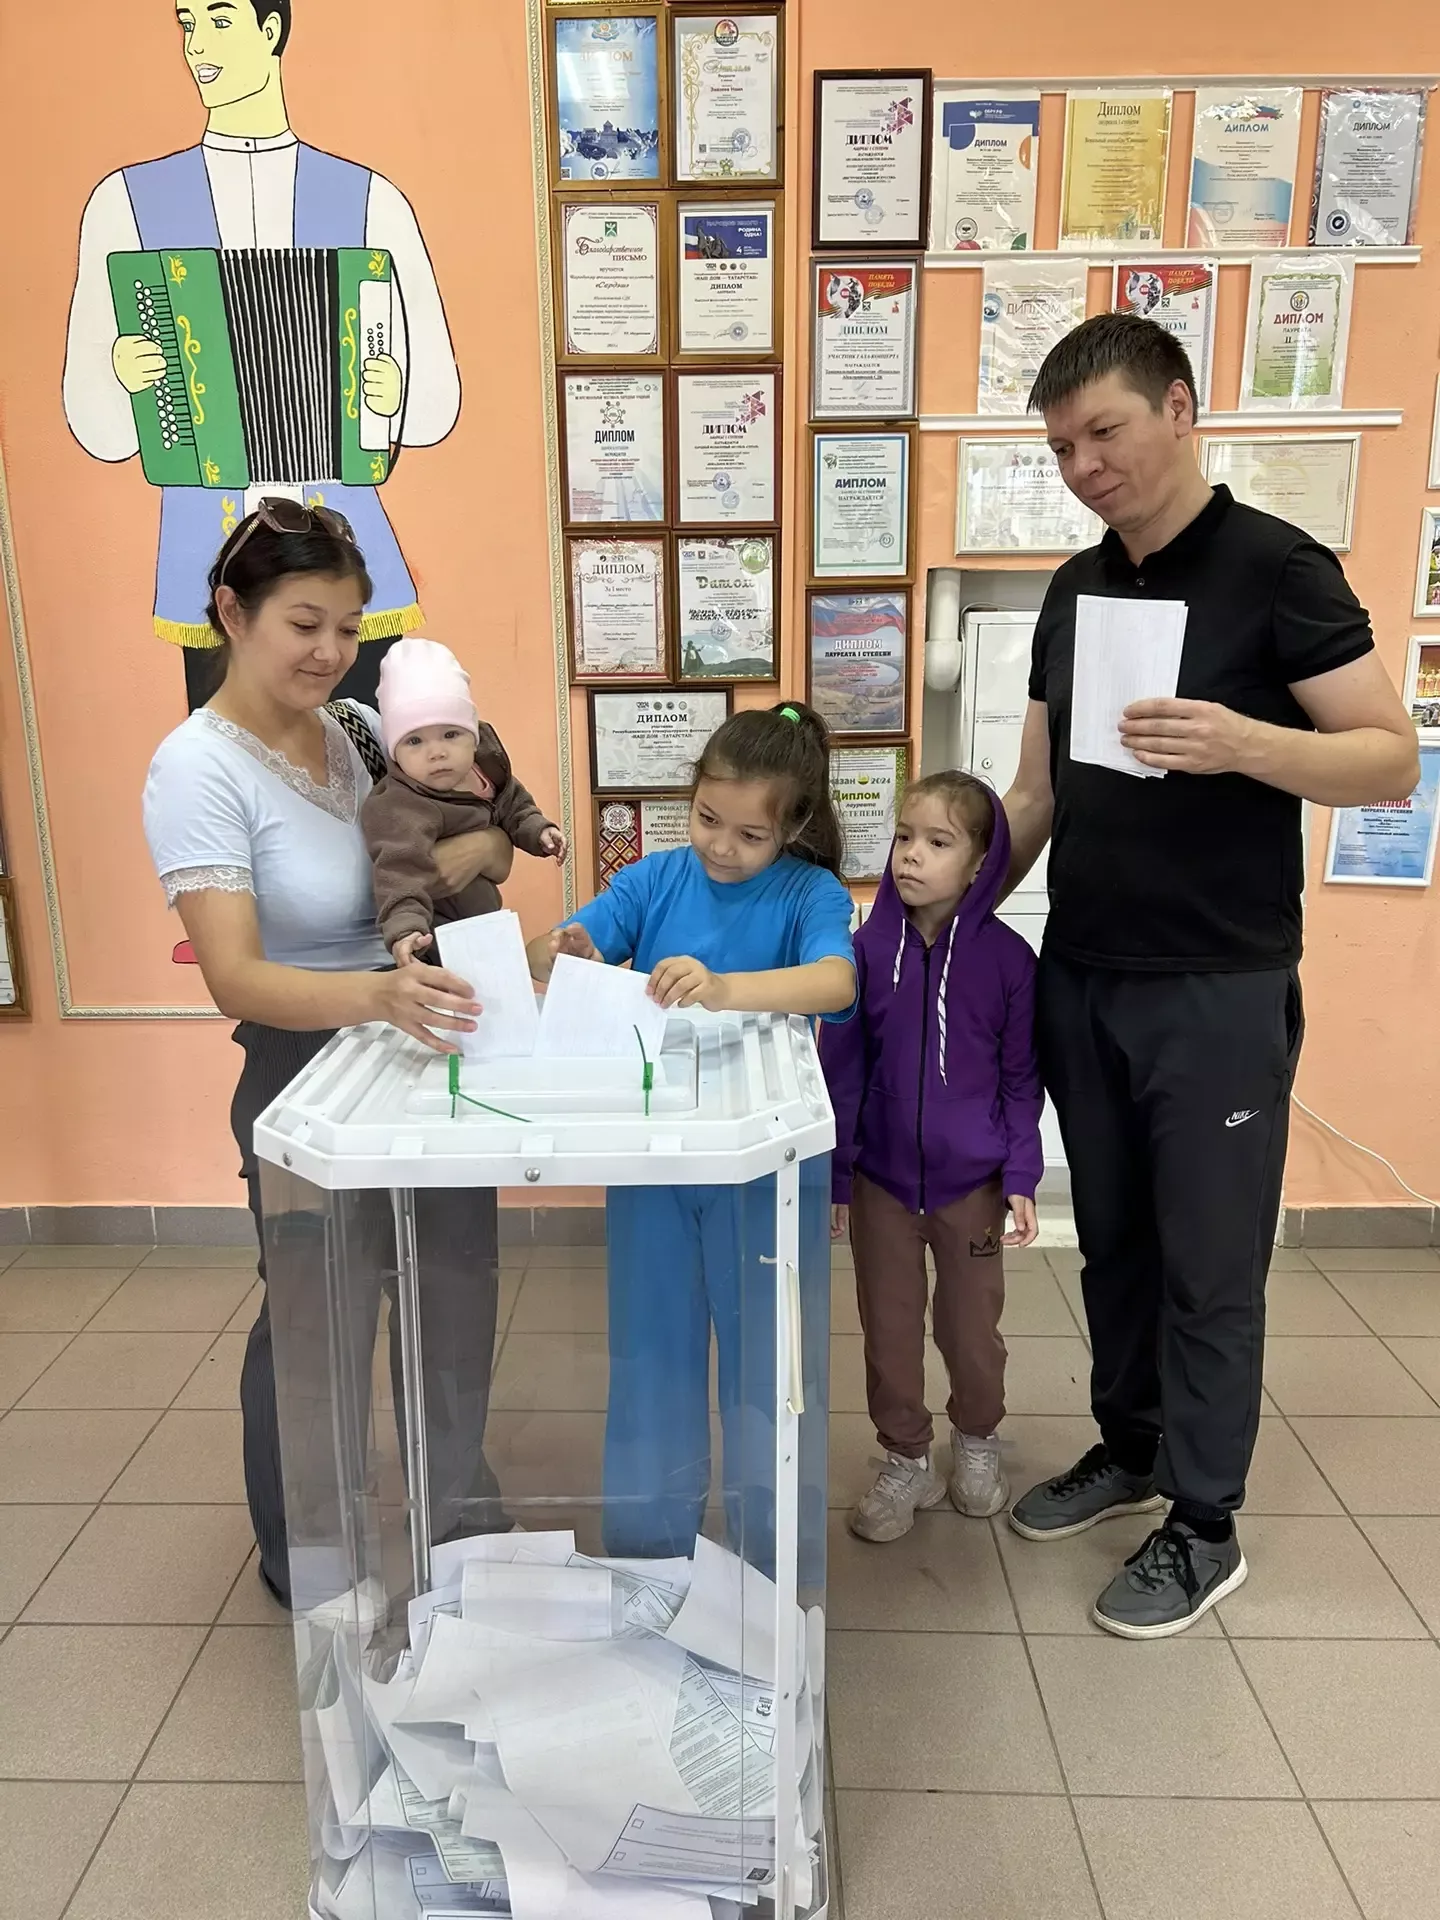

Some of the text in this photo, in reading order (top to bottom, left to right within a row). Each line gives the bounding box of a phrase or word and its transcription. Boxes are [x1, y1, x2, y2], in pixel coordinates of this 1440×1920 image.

[579, 50, 633, 62] ДИЛОМ
[1097, 101, 1141, 118] Диплом
[1224, 123, 1269, 133] ДИПЛОМ
[1353, 122, 1391, 132] ДИПЛОМ
[845, 133, 893, 147] ДИПЛОМ
[974, 139, 1008, 148] ДИПЛОМ
[574, 236, 644, 256] Благодарственное
[736, 246, 742, 254] 4
[612, 254, 648, 262] ПИСЬМО
[868, 273, 895, 281] ПАМЯТЬ
[868, 281, 896, 289] ПОБЕДЫ
[1273, 312, 1324, 325] ДИПЛОМ
[839, 325, 888, 337] ДИПЛОМ
[1285, 336, 1292, 344] II
[702, 424, 747, 435] ДИПЛОМ
[594, 430, 635, 444] ДИПЛОМ
[835, 478, 887, 489] ДИПЛОМ
[592, 564, 645, 575] ДИПЛОМ
[834, 639, 882, 650] ДИПЛОМ
[636, 714, 688, 724] ДИПЛОМ
[833, 789, 881, 802] Диплом
[1231, 1109, 1251, 1121] NIKE
